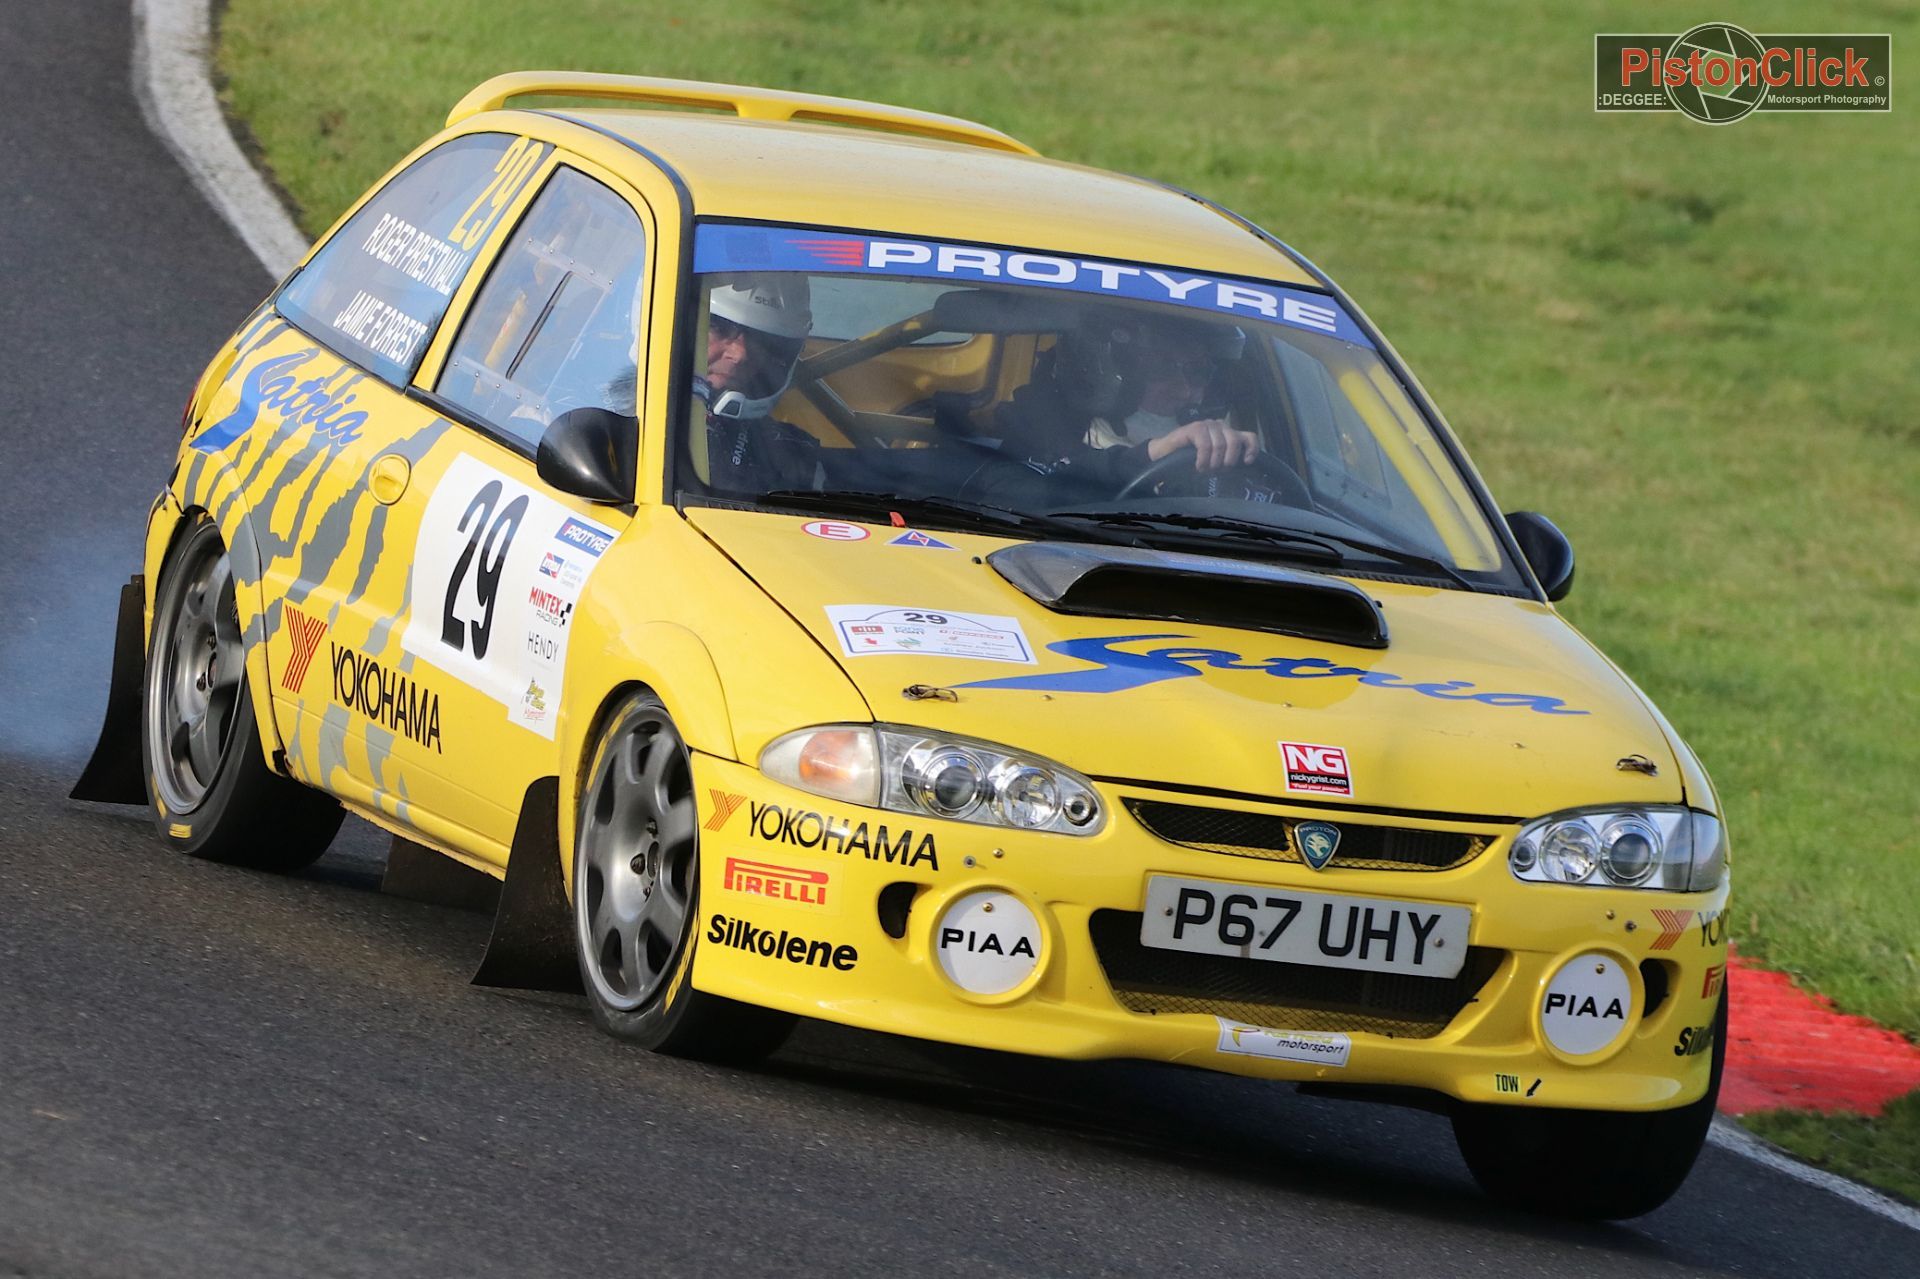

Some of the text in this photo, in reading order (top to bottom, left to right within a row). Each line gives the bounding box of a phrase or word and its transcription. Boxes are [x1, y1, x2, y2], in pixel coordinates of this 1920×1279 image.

[448, 137, 543, 251] 29
[362, 213, 469, 296] ROGER PRIESTNALL
[868, 241, 1337, 332] PROTYRE
[333, 290, 428, 365] JAMIE FORREST
[189, 352, 369, 455] Satria
[564, 524, 609, 553] PROTYRE
[440, 479, 530, 661] 29
[528, 586, 562, 617] MINTEX
[536, 609, 559, 626] RACING
[903, 612, 948, 625] 29
[527, 630, 559, 663] HENDY
[950, 633, 1591, 715] Satria
[331, 641, 442, 755] YOKOHAMA
[1284, 745, 1345, 775] NG
[1290, 774, 1347, 787] nickygrist.com
[749, 800, 939, 872] YOKOHAMA
[1299, 825, 1337, 836] PROTON
[724, 856, 829, 905] PIRELLI
[707, 914, 858, 972] Silkolene
[941, 928, 1036, 958] PIAA
[1173, 887, 1441, 966] P67 UHY
[1697, 908, 1730, 948] YOK
[1545, 992, 1624, 1020] PIAA
[1277, 1039, 1345, 1054] motorsport
[1495, 1073, 1519, 1093] TOW
